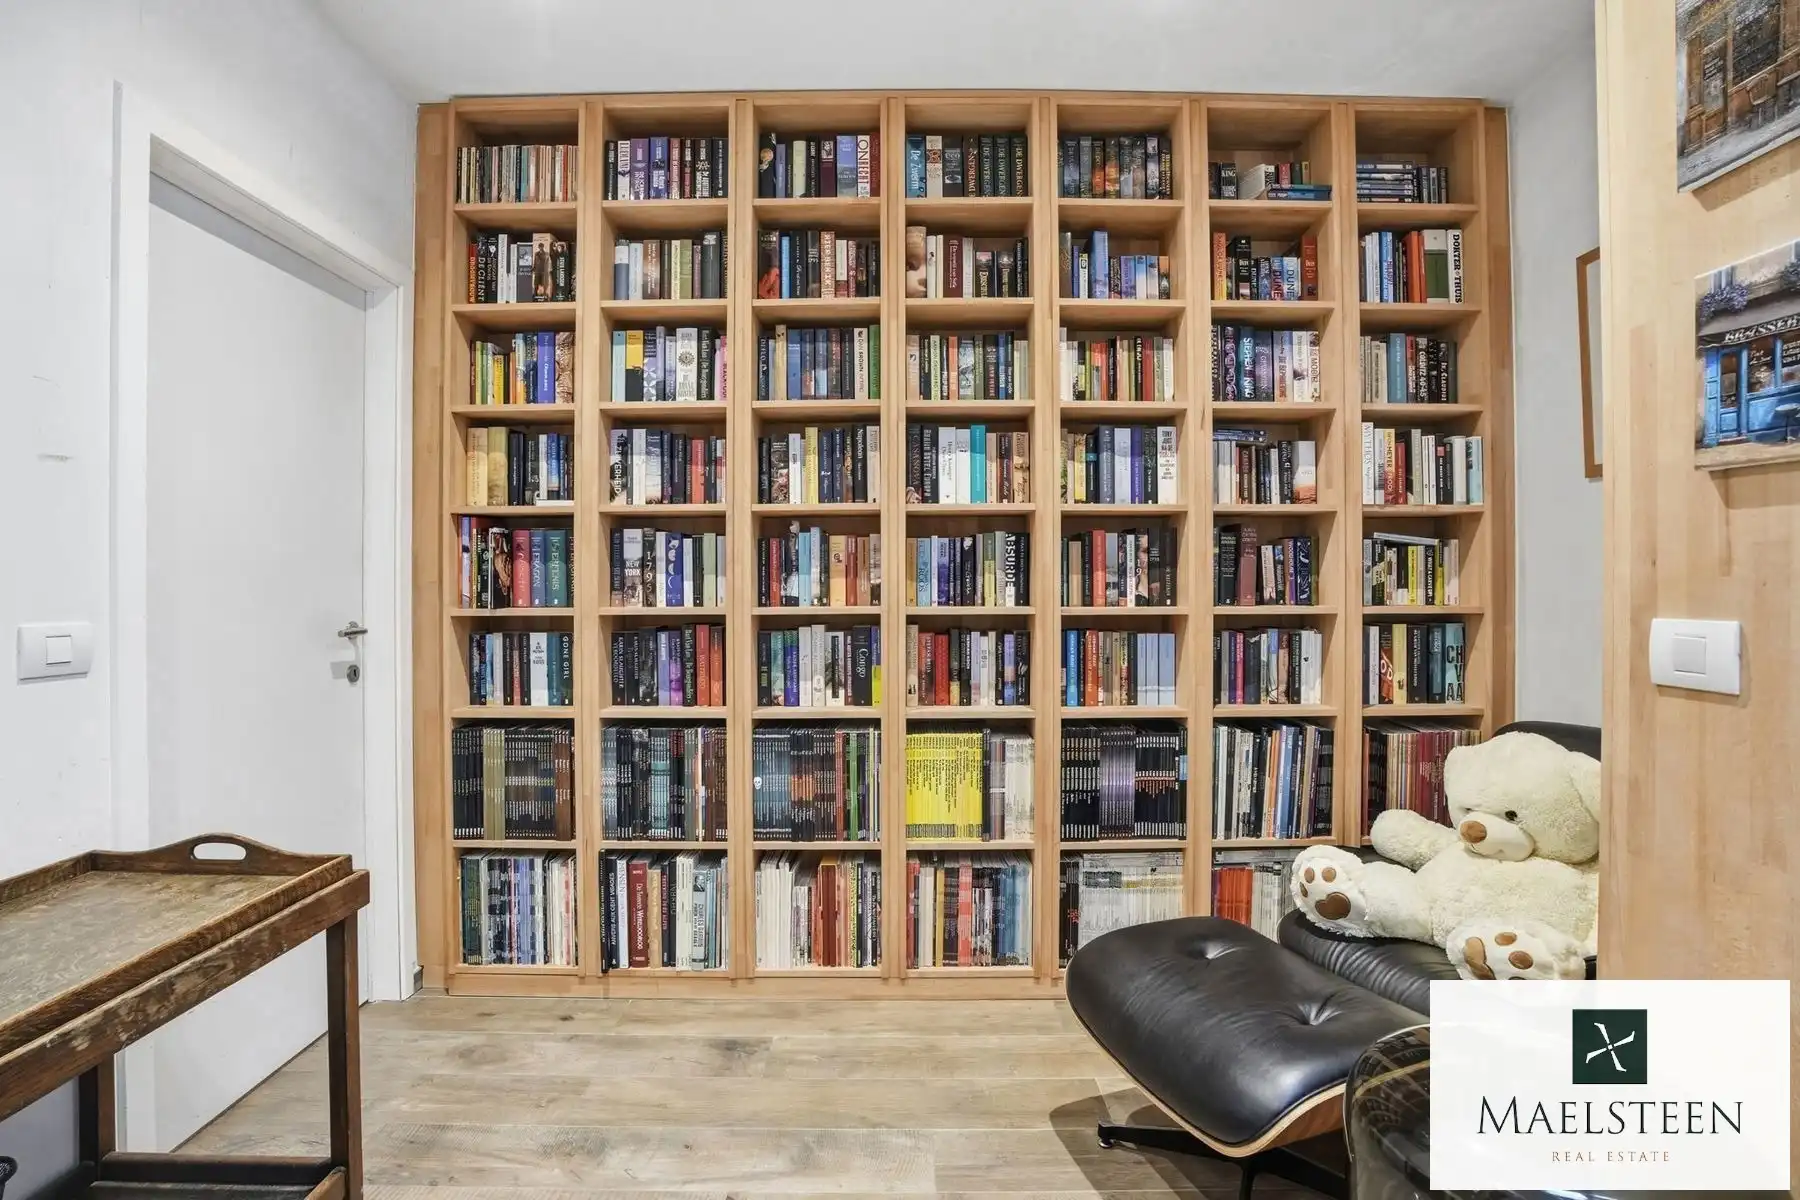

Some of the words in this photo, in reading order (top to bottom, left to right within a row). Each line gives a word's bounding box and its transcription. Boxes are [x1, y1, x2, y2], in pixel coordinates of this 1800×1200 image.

[858, 139, 869, 184] ONRECHT
[912, 150, 921, 160] De
[984, 148, 991, 157] DE
[999, 148, 1006, 158] DE
[1015, 148, 1022, 158] DE
[911, 163, 921, 189] Zwerm
[983, 158, 991, 195] DWERGEN
[998, 159, 1006, 195] DWERGEN
[1453, 233, 1461, 271] DOKTER
[1273, 271, 1282, 299] DUNE
[1286, 269, 1295, 298] DUNE
[1454, 276, 1462, 303] THUIS
[1243, 337, 1253, 371] STEPHEN
[1244, 377, 1254, 399] KING
[856, 428, 865, 460] Napoleon
[1386, 446, 1394, 468] MEYER
[614, 445, 623, 494] ZUIVERHEID
[911, 435, 920, 486] CASANOVA
[624, 568, 641, 577] YORK
[625, 560, 640, 568] NEW
[856, 648, 869, 678] Congo
